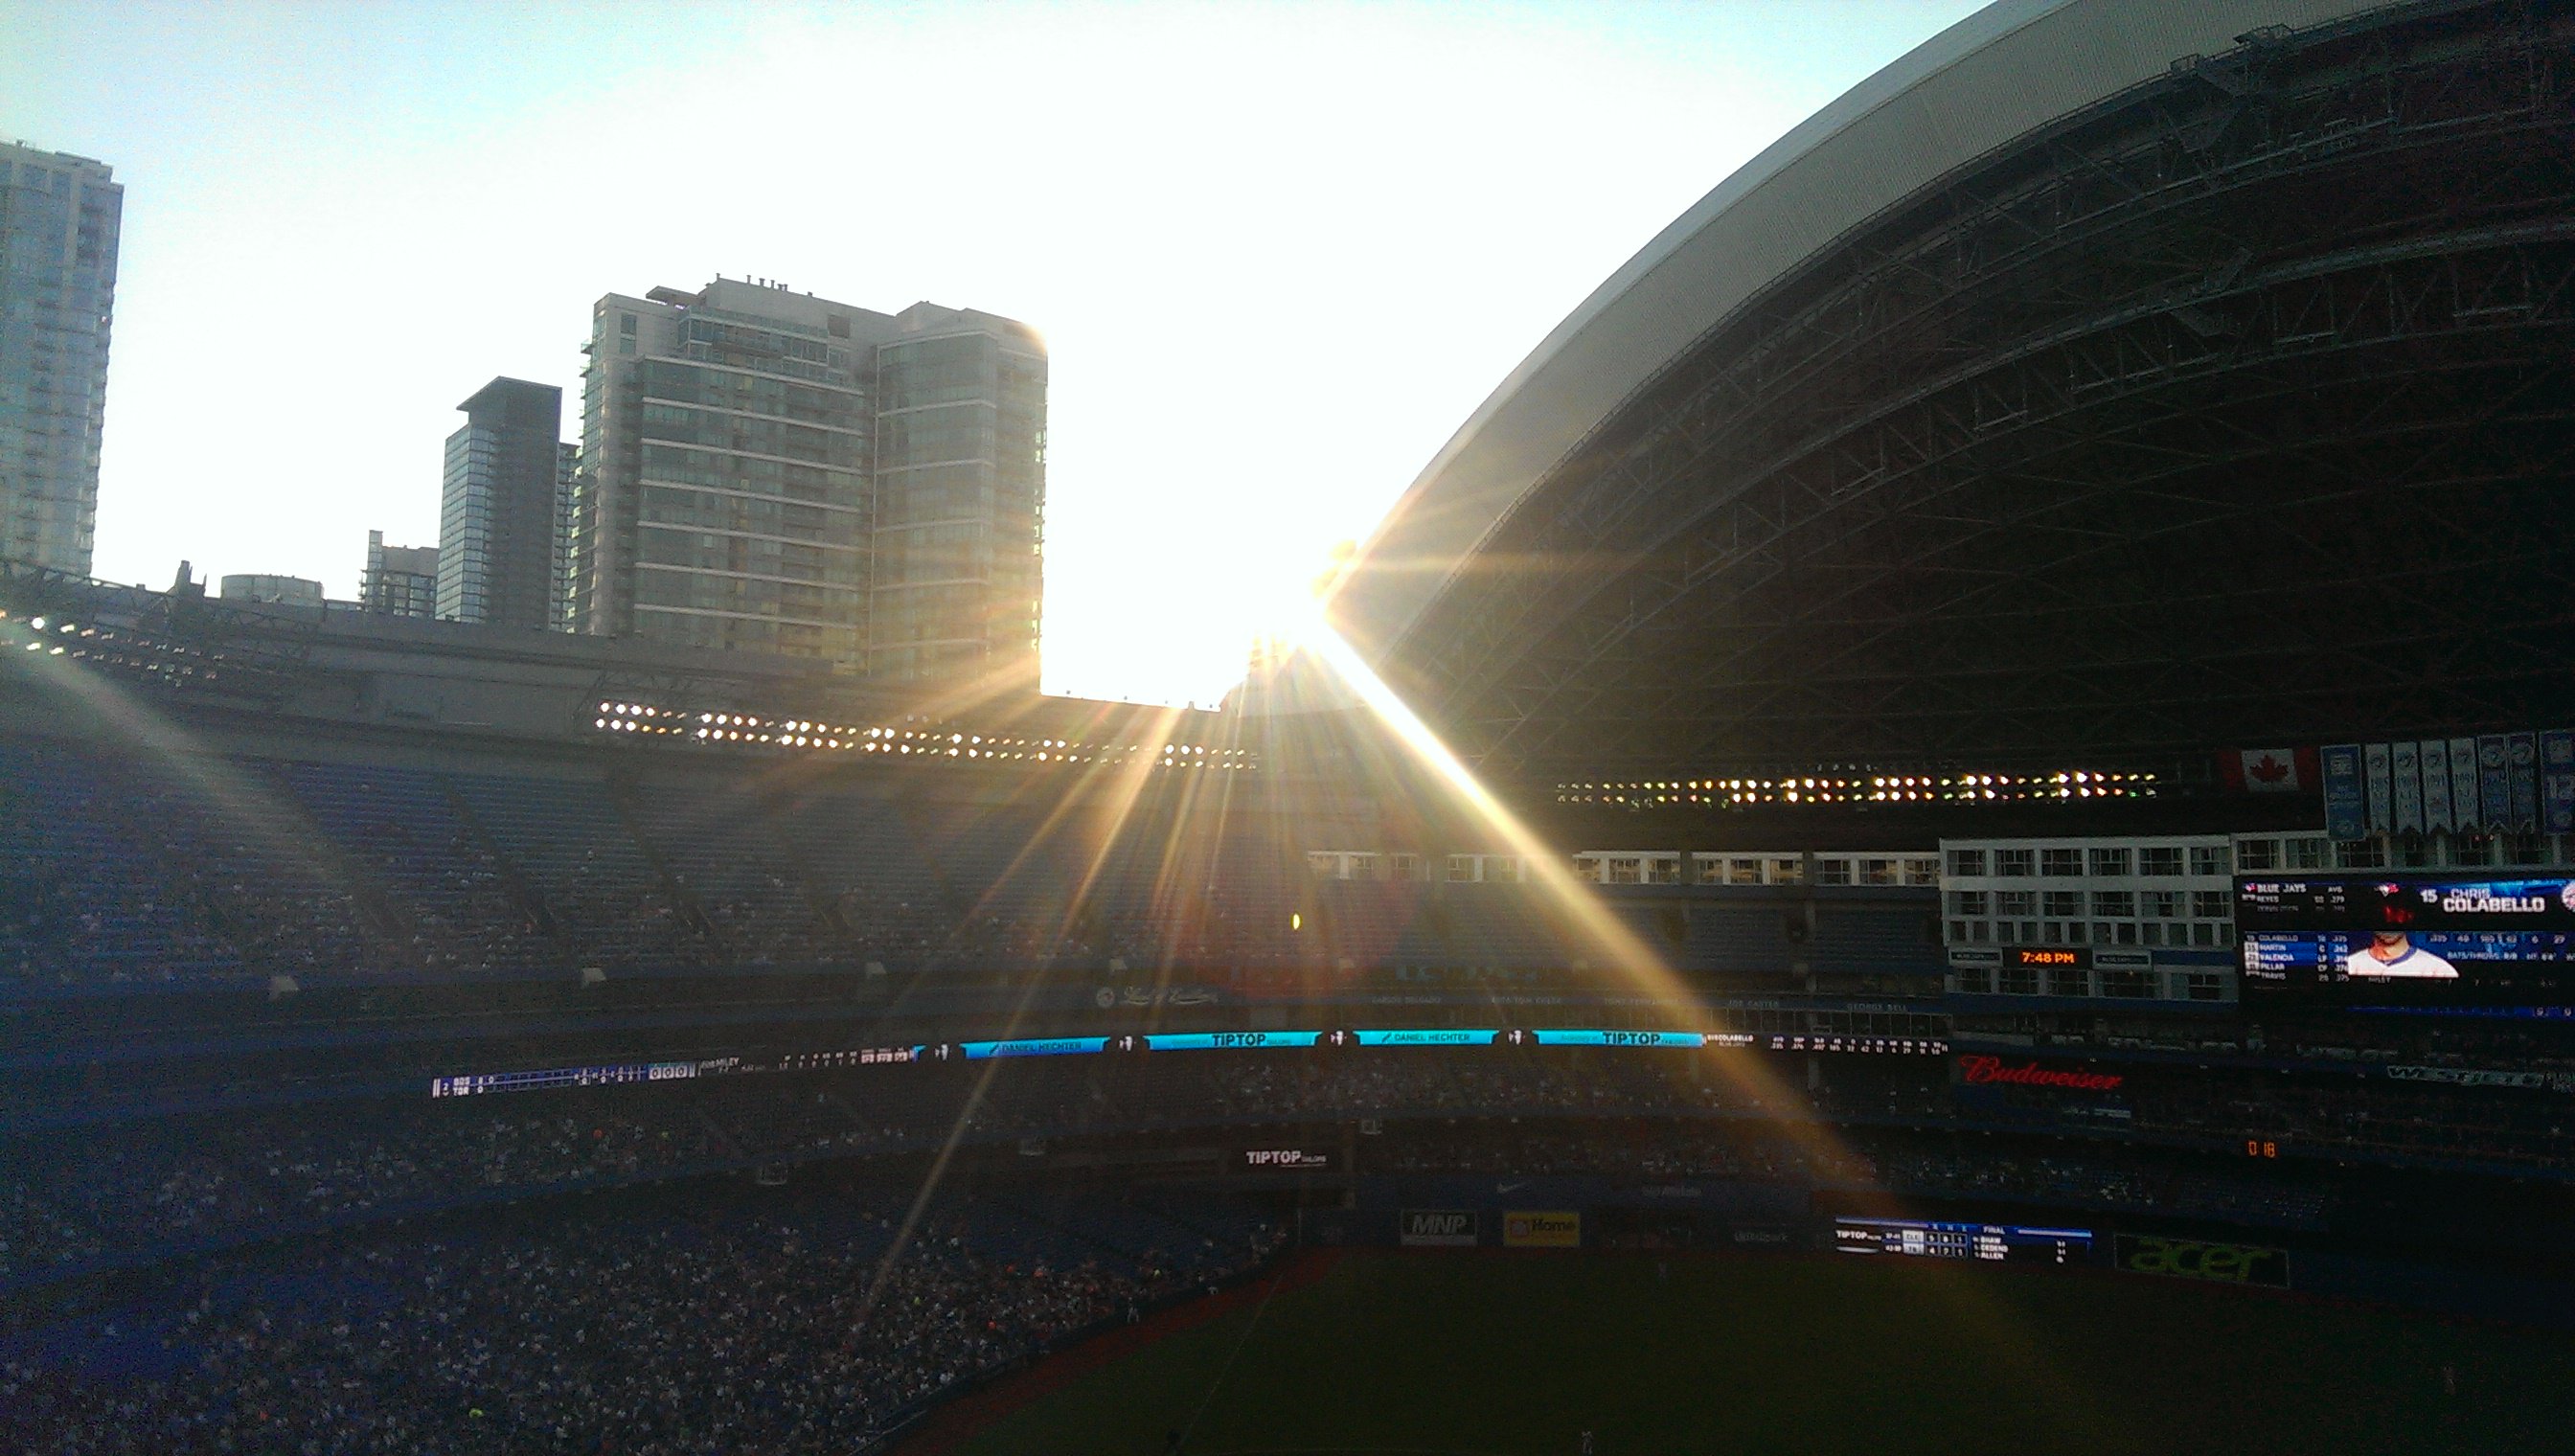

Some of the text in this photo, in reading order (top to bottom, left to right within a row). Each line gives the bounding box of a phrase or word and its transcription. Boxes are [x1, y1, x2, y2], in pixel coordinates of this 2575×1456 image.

[2257, 884, 2280, 893] BLUE
[2283, 883, 2307, 893] JAYS
[2450, 888, 2491, 899] CHRIS
[2421, 889, 2438, 903] 15
[2443, 898, 2545, 913] COLABELLO
[2021, 951, 2075, 965] 7:48 PM
[1212, 1034, 1265, 1047] TIPTOP
[1395, 1034, 1470, 1042] DANIEL HECHTER
[1602, 1032, 1661, 1045] TIPTOP
[1959, 1053, 2124, 1091] Budweiser
[1246, 1149, 1302, 1164] TIPTOP
[1411, 1214, 1467, 1235] MNP
[1983, 1226, 2005, 1235] FINAL
[1836, 1230, 1867, 1240] TIPTOP
[2130, 1236, 2271, 1281] acer
